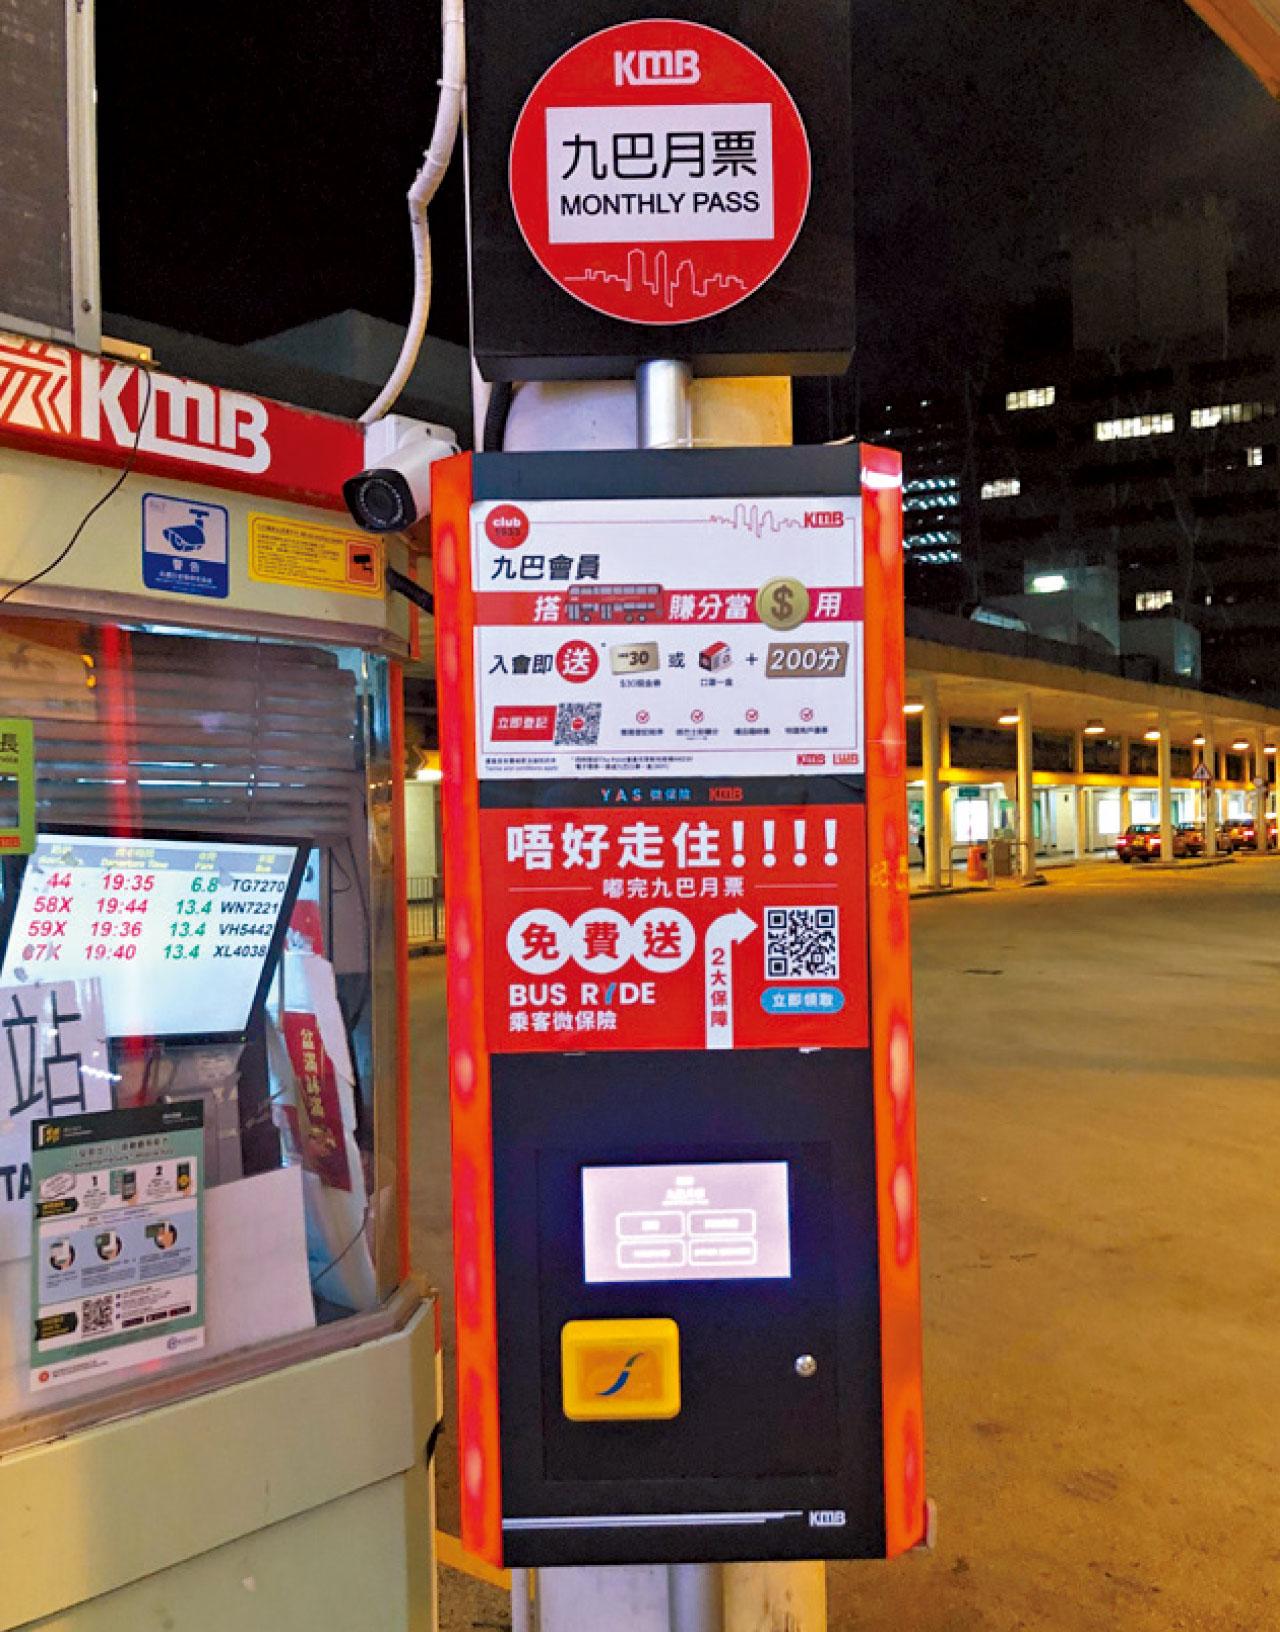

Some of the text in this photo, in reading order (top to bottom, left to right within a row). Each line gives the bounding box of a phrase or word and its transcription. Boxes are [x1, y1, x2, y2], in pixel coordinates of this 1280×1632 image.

[614, 50, 701, 87] KMB
[562, 131, 757, 181] 九巴月票
[560, 191, 760, 216] MONTHLY PASS
[81, 353, 271, 474] KMB
[493, 517, 521, 528] club
[491, 554, 600, 580] 九巴會員
[533, 595, 561, 622] 搭
[814, 592, 842, 618] 用
[770, 647, 840, 670] 200分
[47, 873, 72, 888] 44
[103, 874, 155, 890] 19:35
[191, 877, 219, 892] 6.8
[33, 896, 73, 913] 58X
[97, 898, 148, 914] 19:44
[176, 899, 212, 914] 13.4
[28, 920, 67, 937] 59X
[91, 921, 142, 937] 19:36
[170, 922, 206, 936] 13.4
[86, 944, 137, 960] 19:40
[164, 945, 200, 959] 13.4
[520, 921, 684, 961] 免費送
[509, 983, 567, 1006] BUS
[508, 1011, 617, 1032] 乘客微保險
[2, 990, 86, 1117] 站
